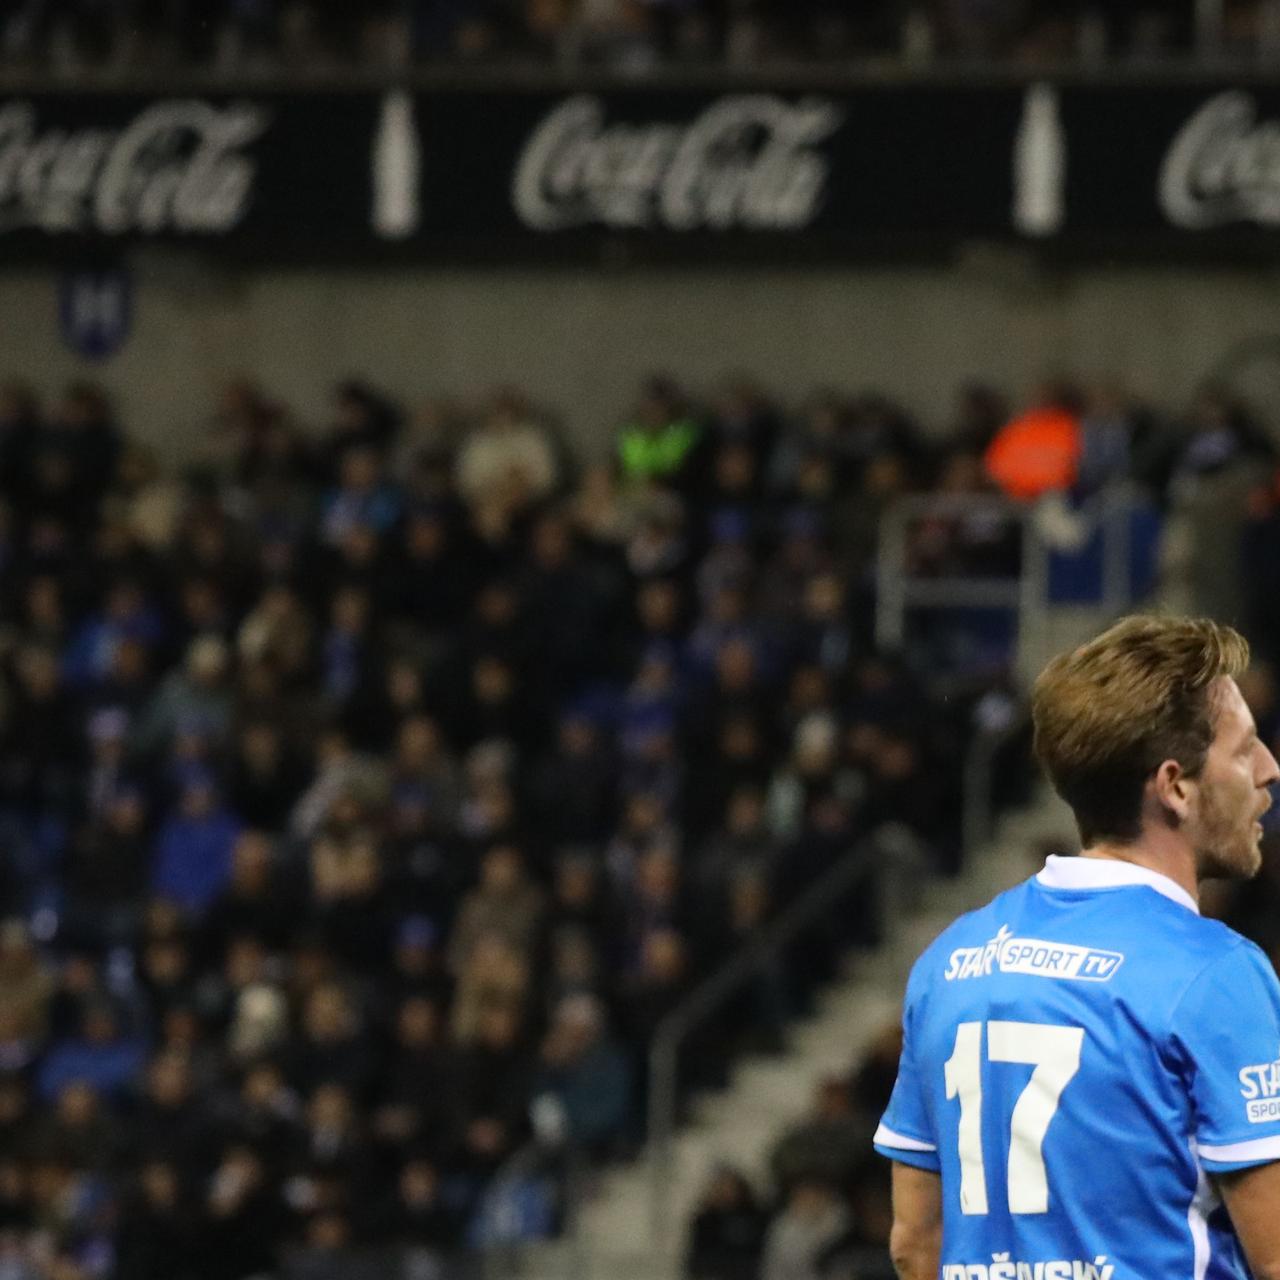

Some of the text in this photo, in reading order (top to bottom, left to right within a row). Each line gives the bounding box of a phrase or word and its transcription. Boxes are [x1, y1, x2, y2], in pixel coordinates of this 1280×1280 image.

[945, 941, 1116, 982] STAR SPORT TV
[944, 1020, 1085, 1216] 17
